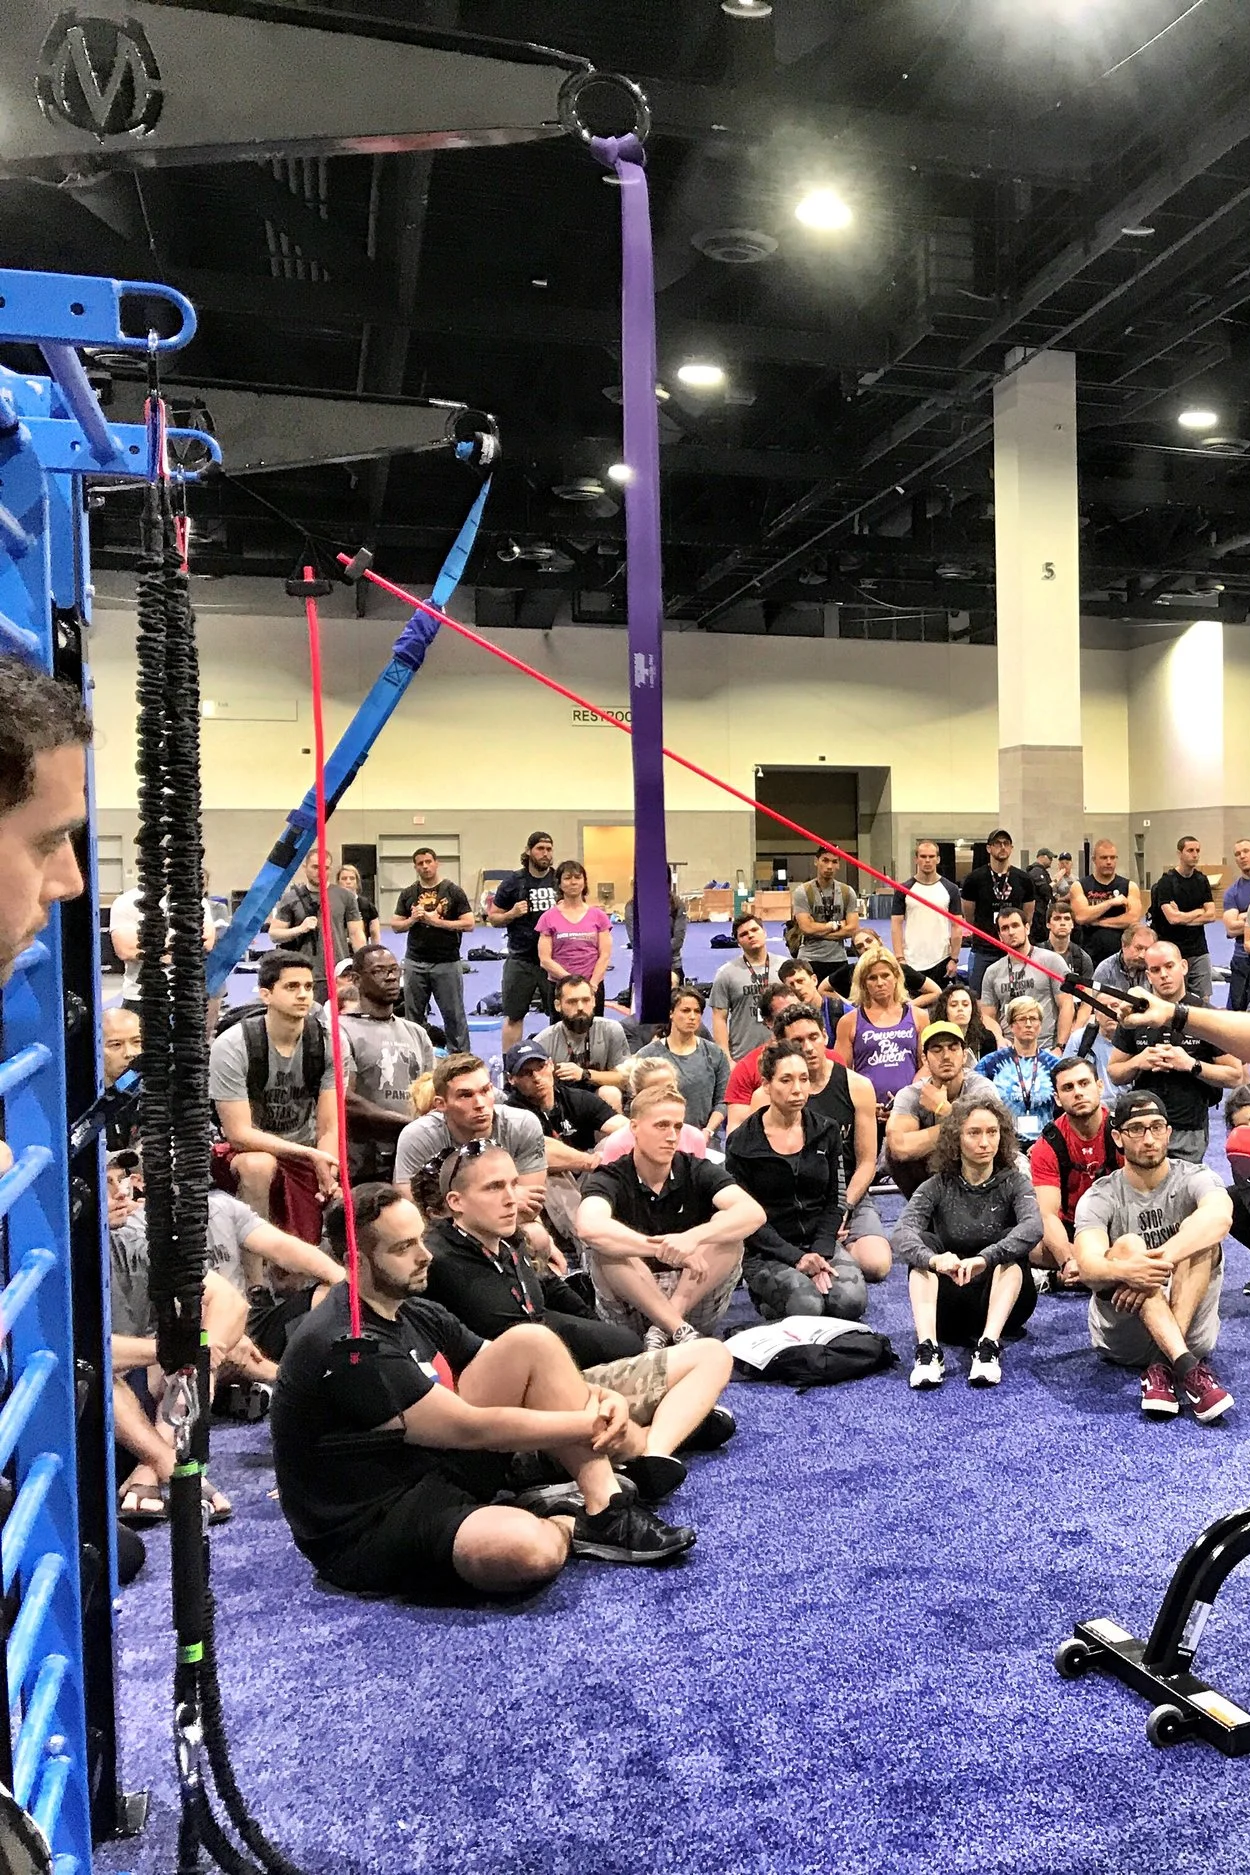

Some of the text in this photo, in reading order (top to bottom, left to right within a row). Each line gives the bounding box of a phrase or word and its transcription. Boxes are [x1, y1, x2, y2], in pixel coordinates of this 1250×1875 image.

[1043, 561, 1055, 580] 5
[862, 1027, 914, 1044] Powered
[878, 1040, 899, 1054] By
[868, 1048, 912, 1066] Sweat
[1139, 1208, 1163, 1231] STOP
